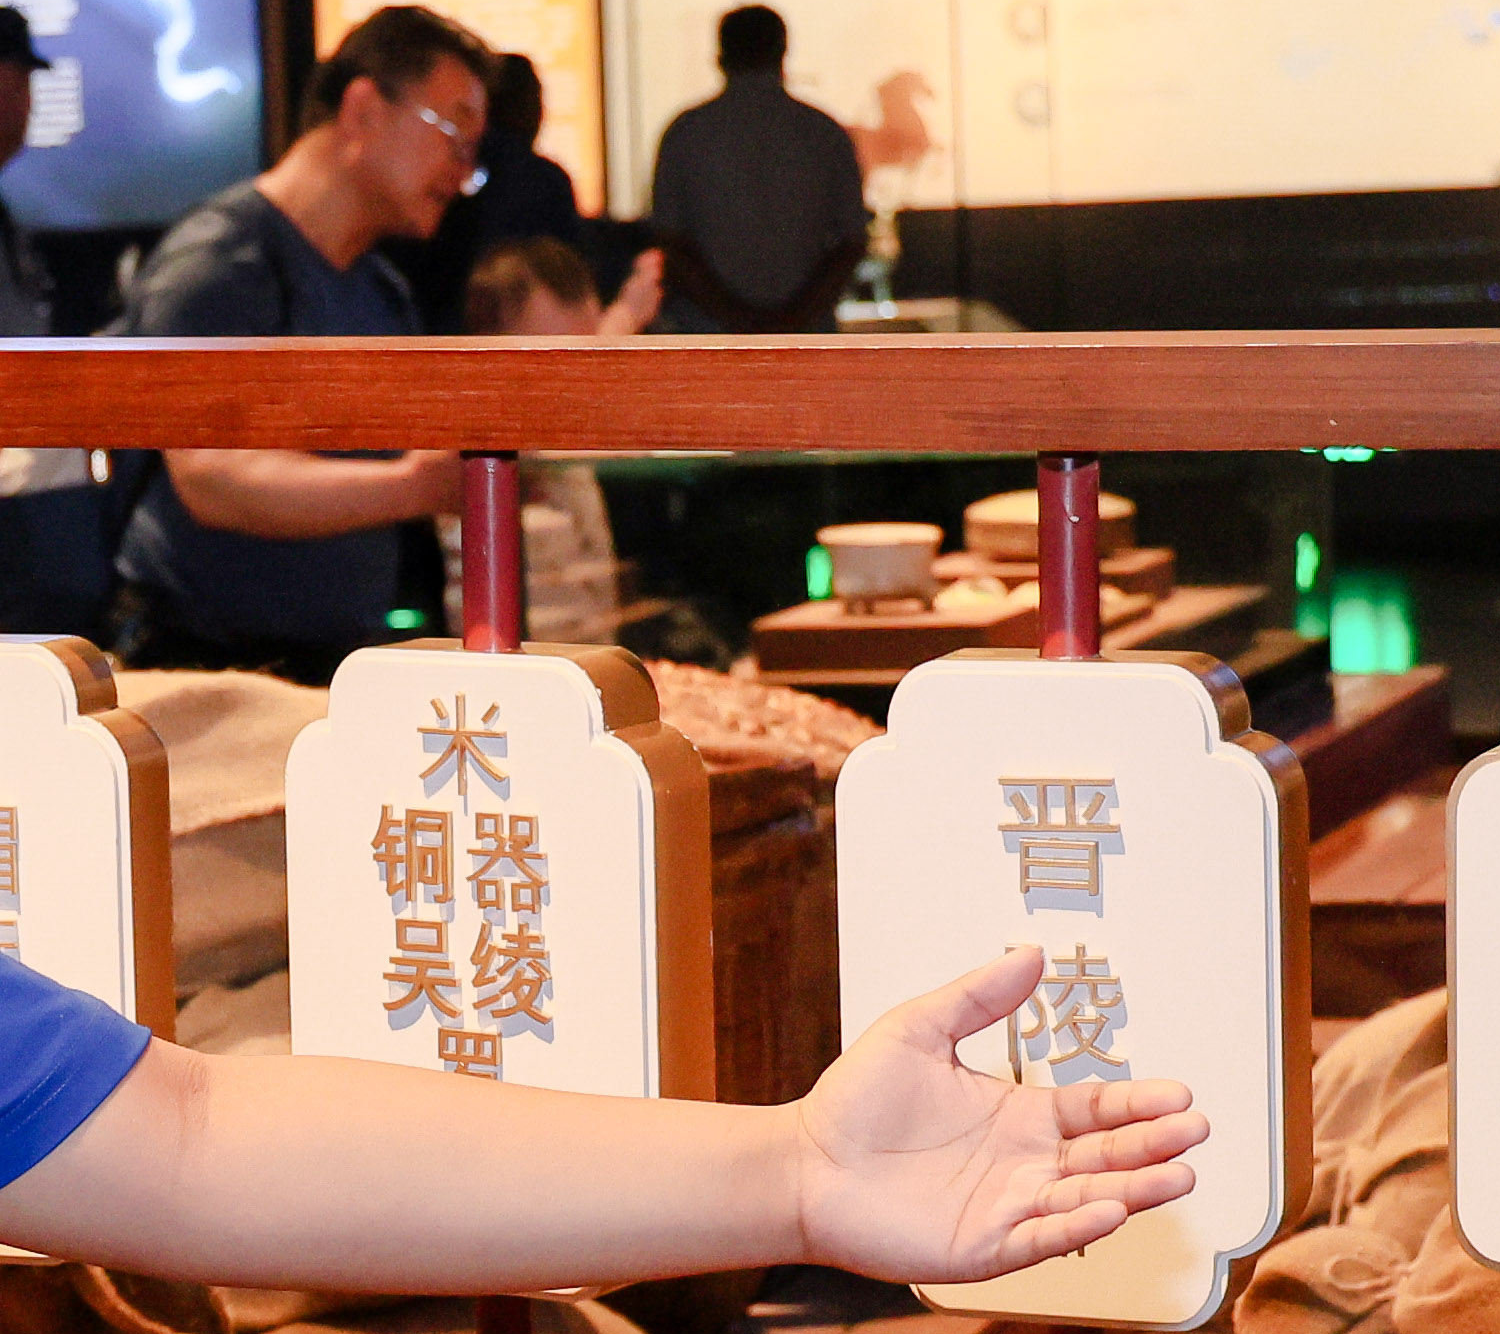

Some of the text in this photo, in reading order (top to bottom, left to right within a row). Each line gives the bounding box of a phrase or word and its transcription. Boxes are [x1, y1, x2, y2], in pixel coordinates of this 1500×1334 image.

[417, 691, 508, 796] 米
[371, 804, 549, 914] 铜器
[382, 919, 553, 1024] 吴绫
[997, 776, 1125, 1257] 晋陵
